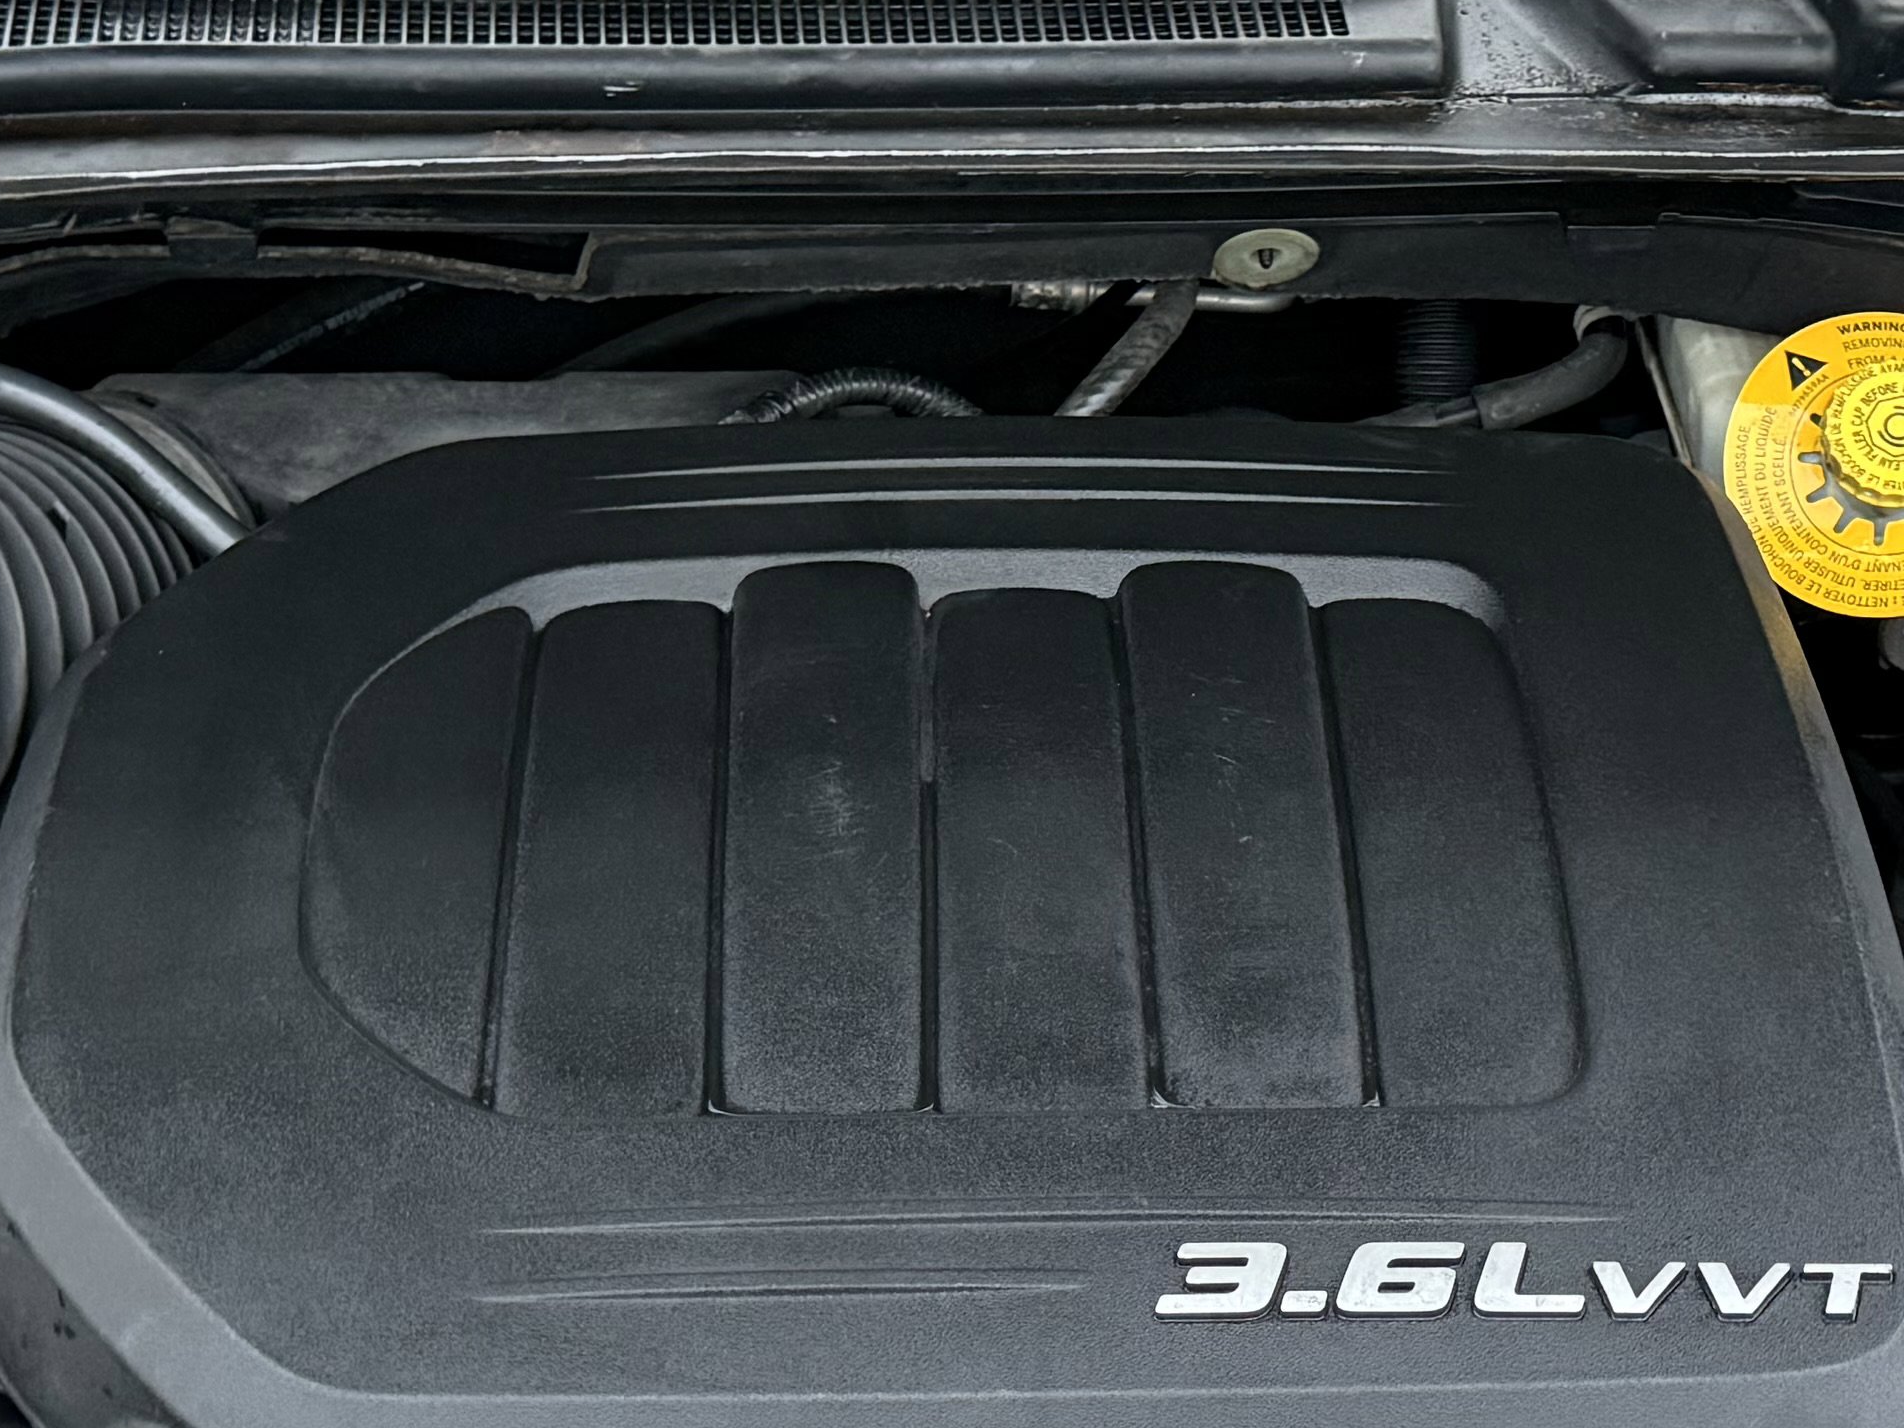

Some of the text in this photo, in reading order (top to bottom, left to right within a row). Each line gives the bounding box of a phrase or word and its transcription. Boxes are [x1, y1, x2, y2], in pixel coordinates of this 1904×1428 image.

[1861, 382, 1898, 406] BEFORE
[1852, 406, 1866, 426] CAP
[1755, 407, 1777, 458] LIQUIDE
[1852, 431, 1879, 461] FILLER
[1735, 425, 1755, 515] REMPLISSAGE
[1755, 464, 1767, 481] DU
[1756, 485, 1805, 562] UNIQUEMENT
[1776, 490, 1829, 555] CONTENANT
[1758, 536, 1806, 585] BOUCHON
[1803, 556, 1856, 587] UTILISER
[1828, 553, 1862, 571] D'UN
[1805, 579, 1822, 594] LE
[1823, 588, 1889, 608] NETTOYER
[1153, 1240, 1895, 1325] 3.6L VVT
